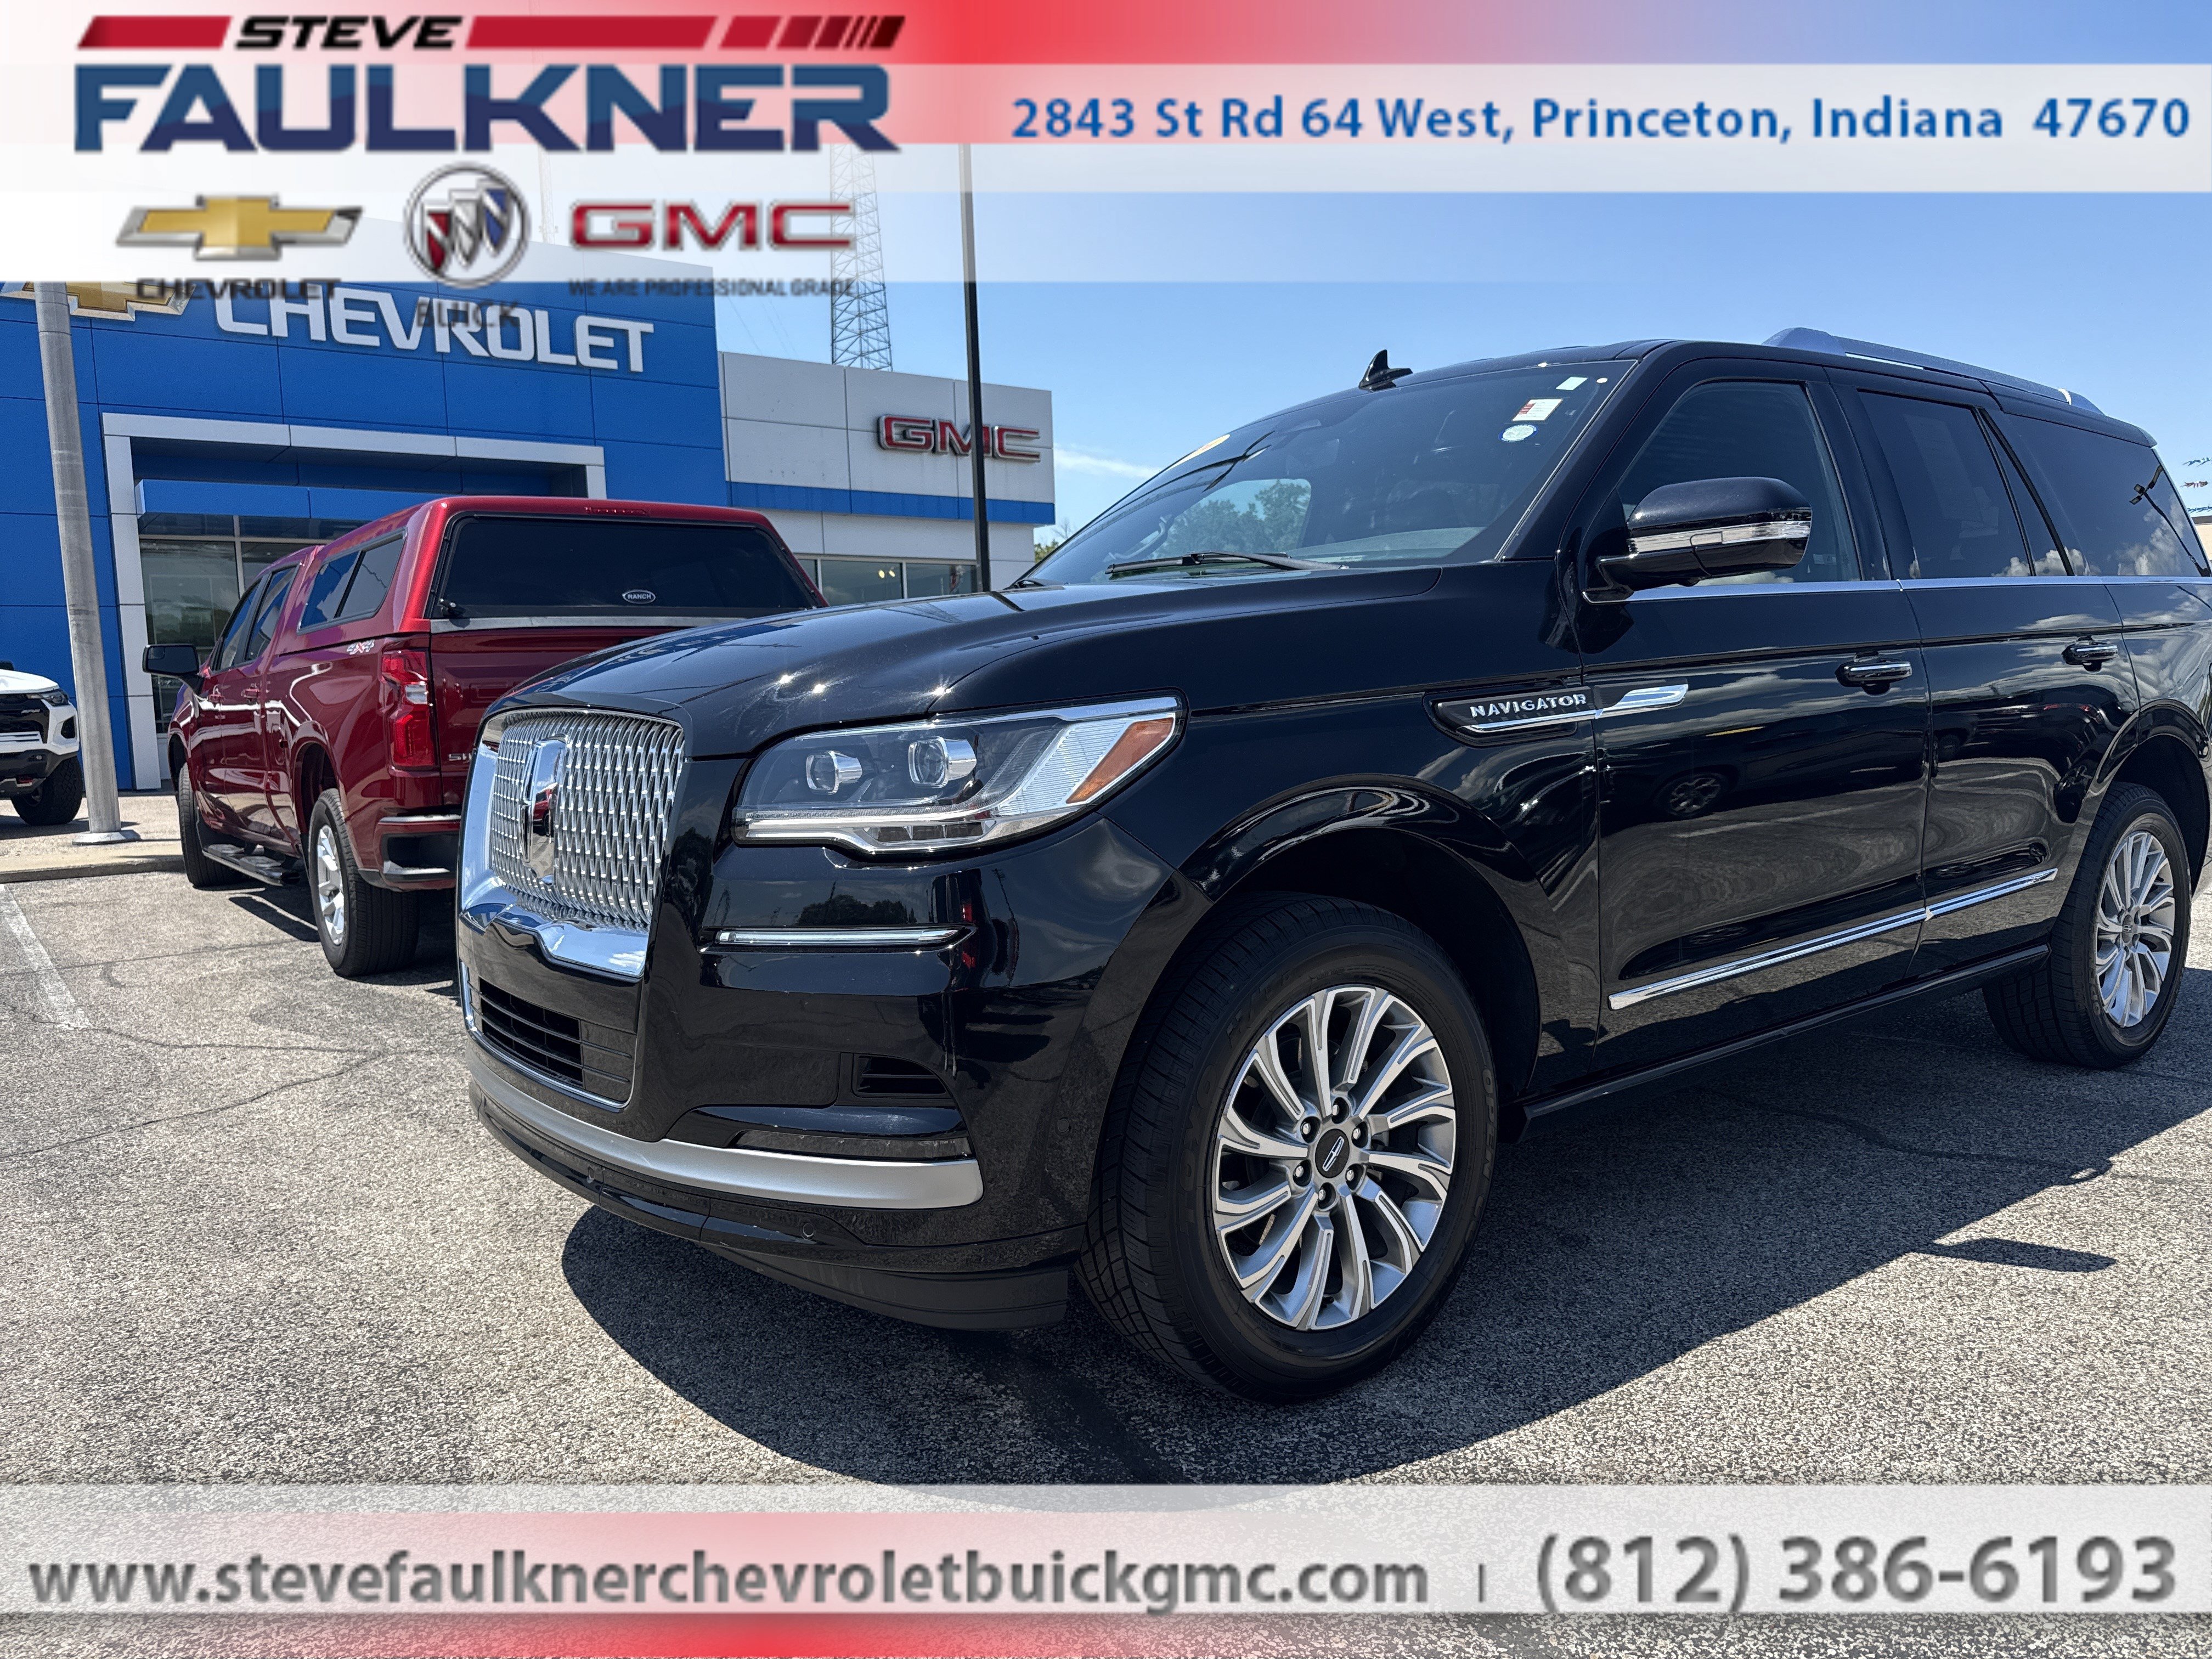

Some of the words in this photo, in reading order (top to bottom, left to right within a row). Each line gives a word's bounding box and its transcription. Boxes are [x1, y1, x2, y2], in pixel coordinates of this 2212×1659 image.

[215, 282, 654, 373] CHEVROLET
[878, 415, 1041, 462] GMC
[1470, 693, 1587, 718] NAVIGATOR
[1481, 1069, 1496, 1181] OPEN
